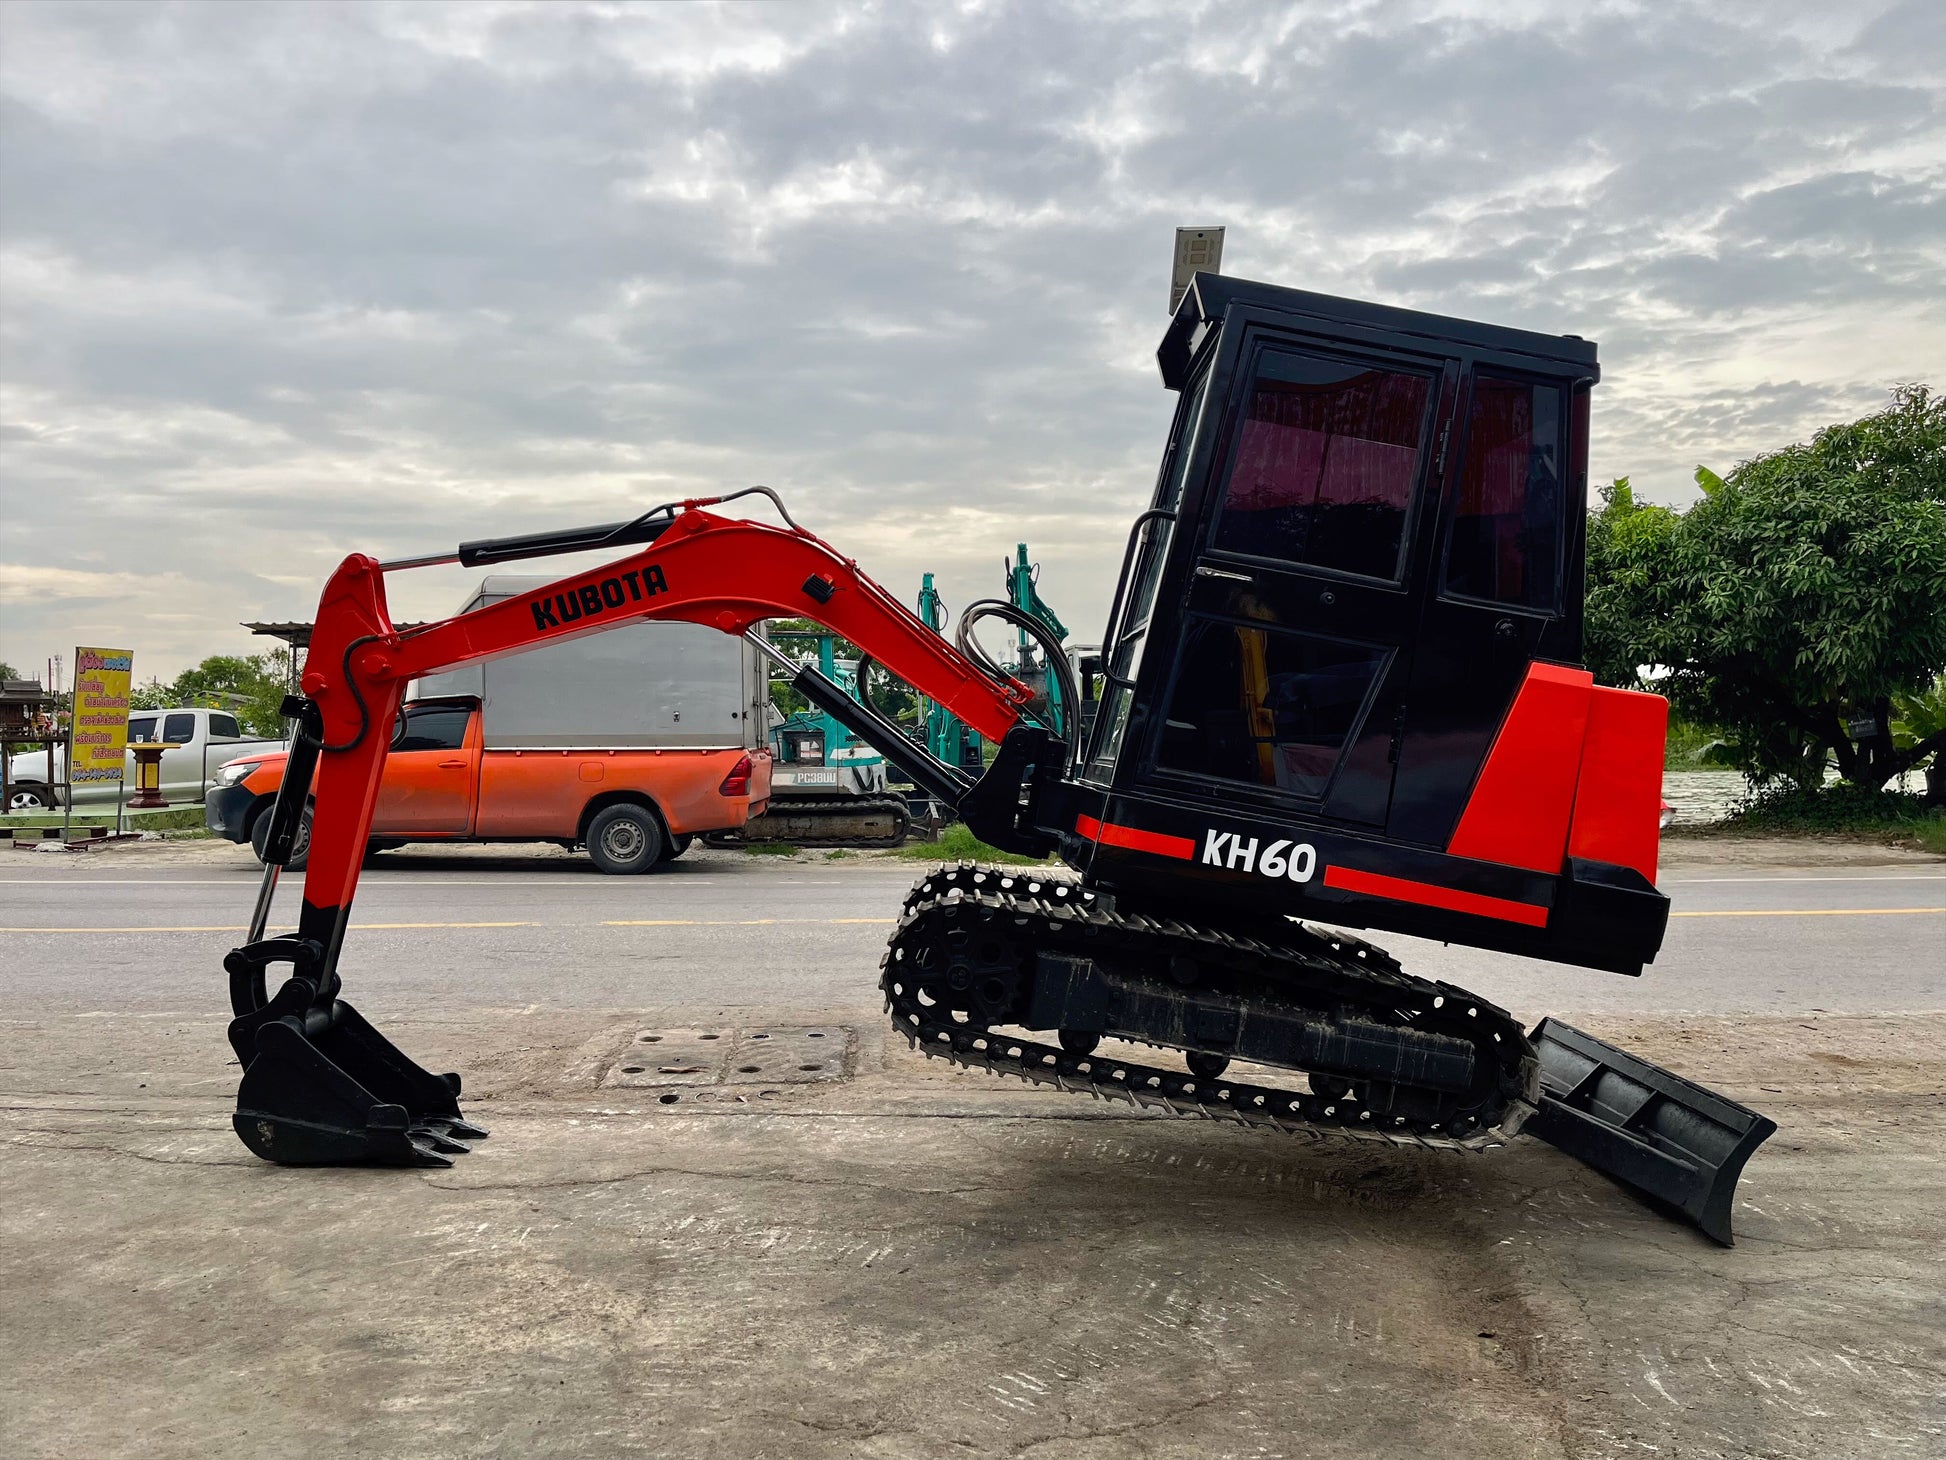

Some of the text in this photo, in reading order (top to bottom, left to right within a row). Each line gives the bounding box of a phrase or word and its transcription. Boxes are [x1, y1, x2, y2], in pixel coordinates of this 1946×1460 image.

[531, 565, 668, 631] KUBOTA
[797, 772, 836, 783] PC38UU
[1201, 828, 1317, 883] KH60
